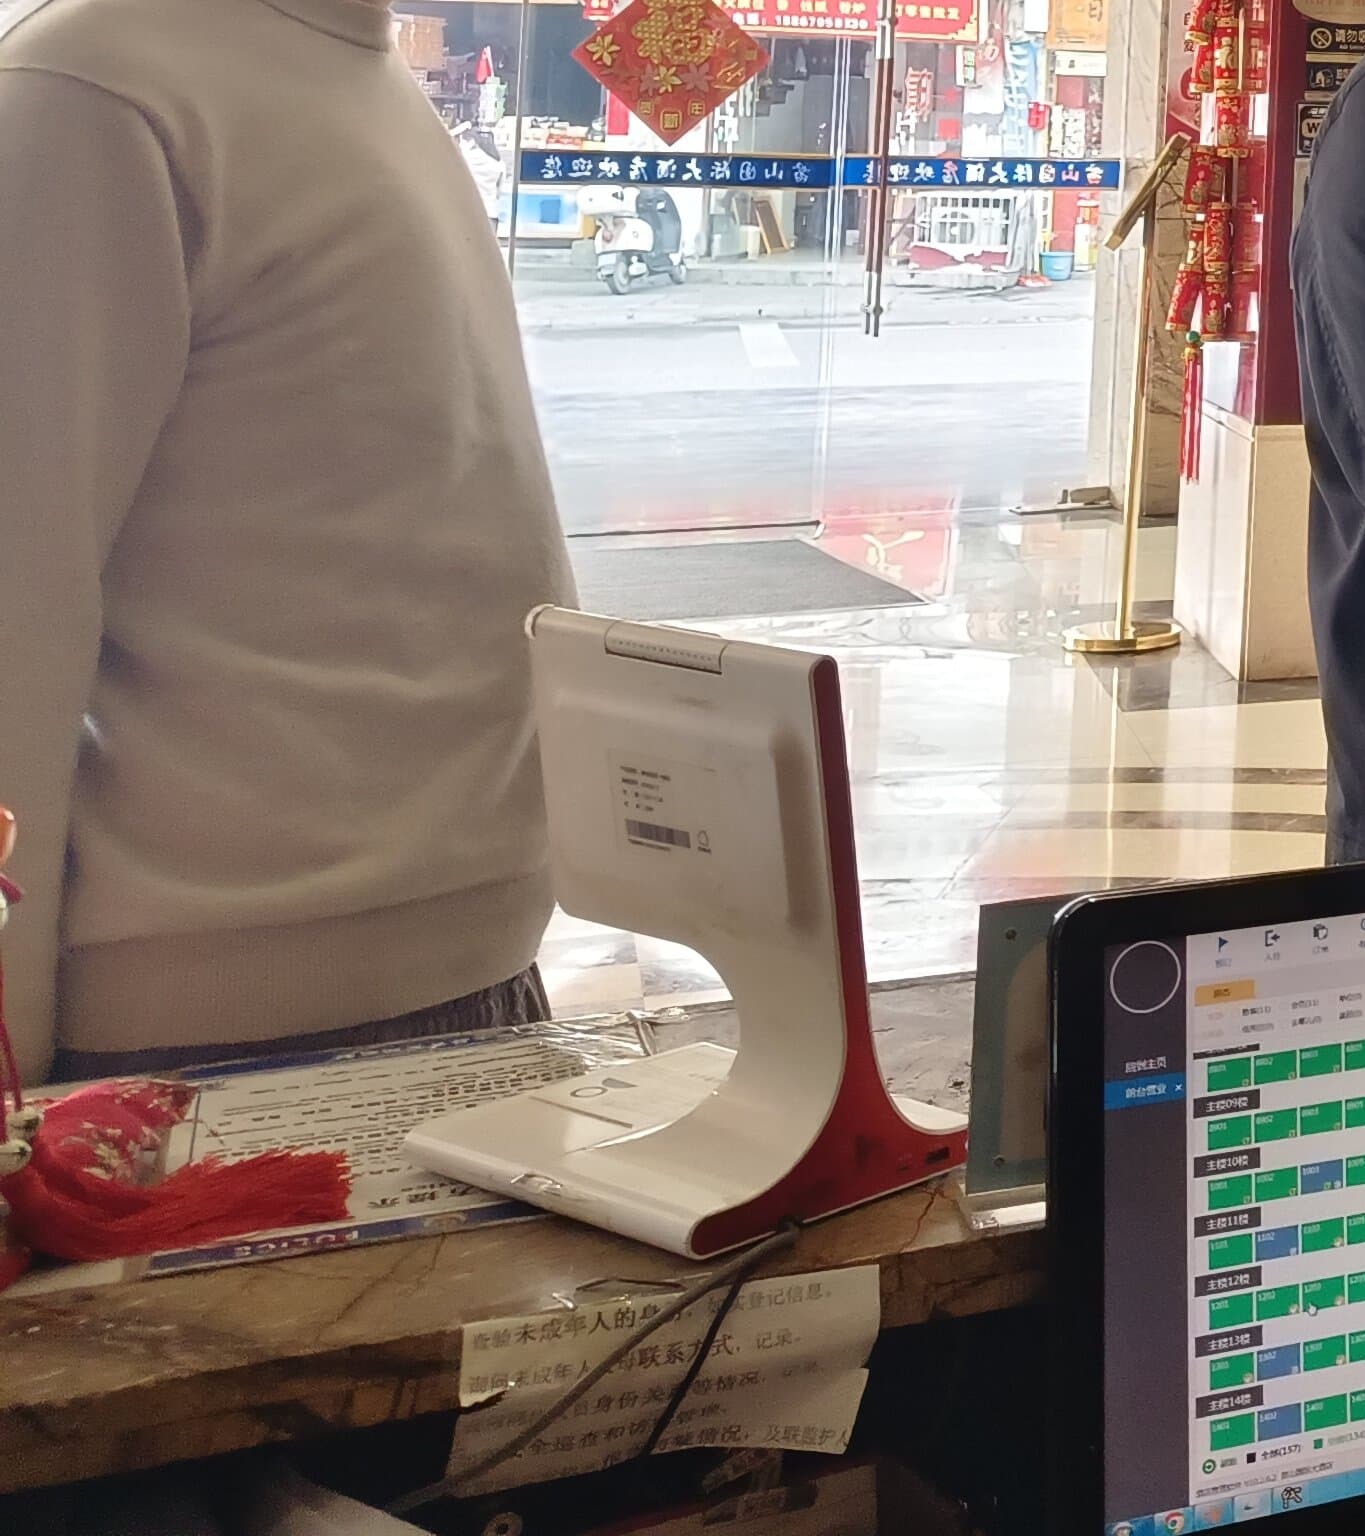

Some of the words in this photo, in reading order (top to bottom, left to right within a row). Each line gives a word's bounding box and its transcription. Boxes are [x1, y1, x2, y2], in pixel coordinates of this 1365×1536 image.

[1205, 1096, 1249, 1113] 主楼09楼
[1205, 1154, 1249, 1172] 主楼10楼
[1206, 1213, 1249, 1230] 主楼11楼
[1206, 1273, 1250, 1291] 主楼12楼
[1207, 1333, 1251, 1352] 主楼13楼
[1207, 1392, 1252, 1412] 主楼14楼
